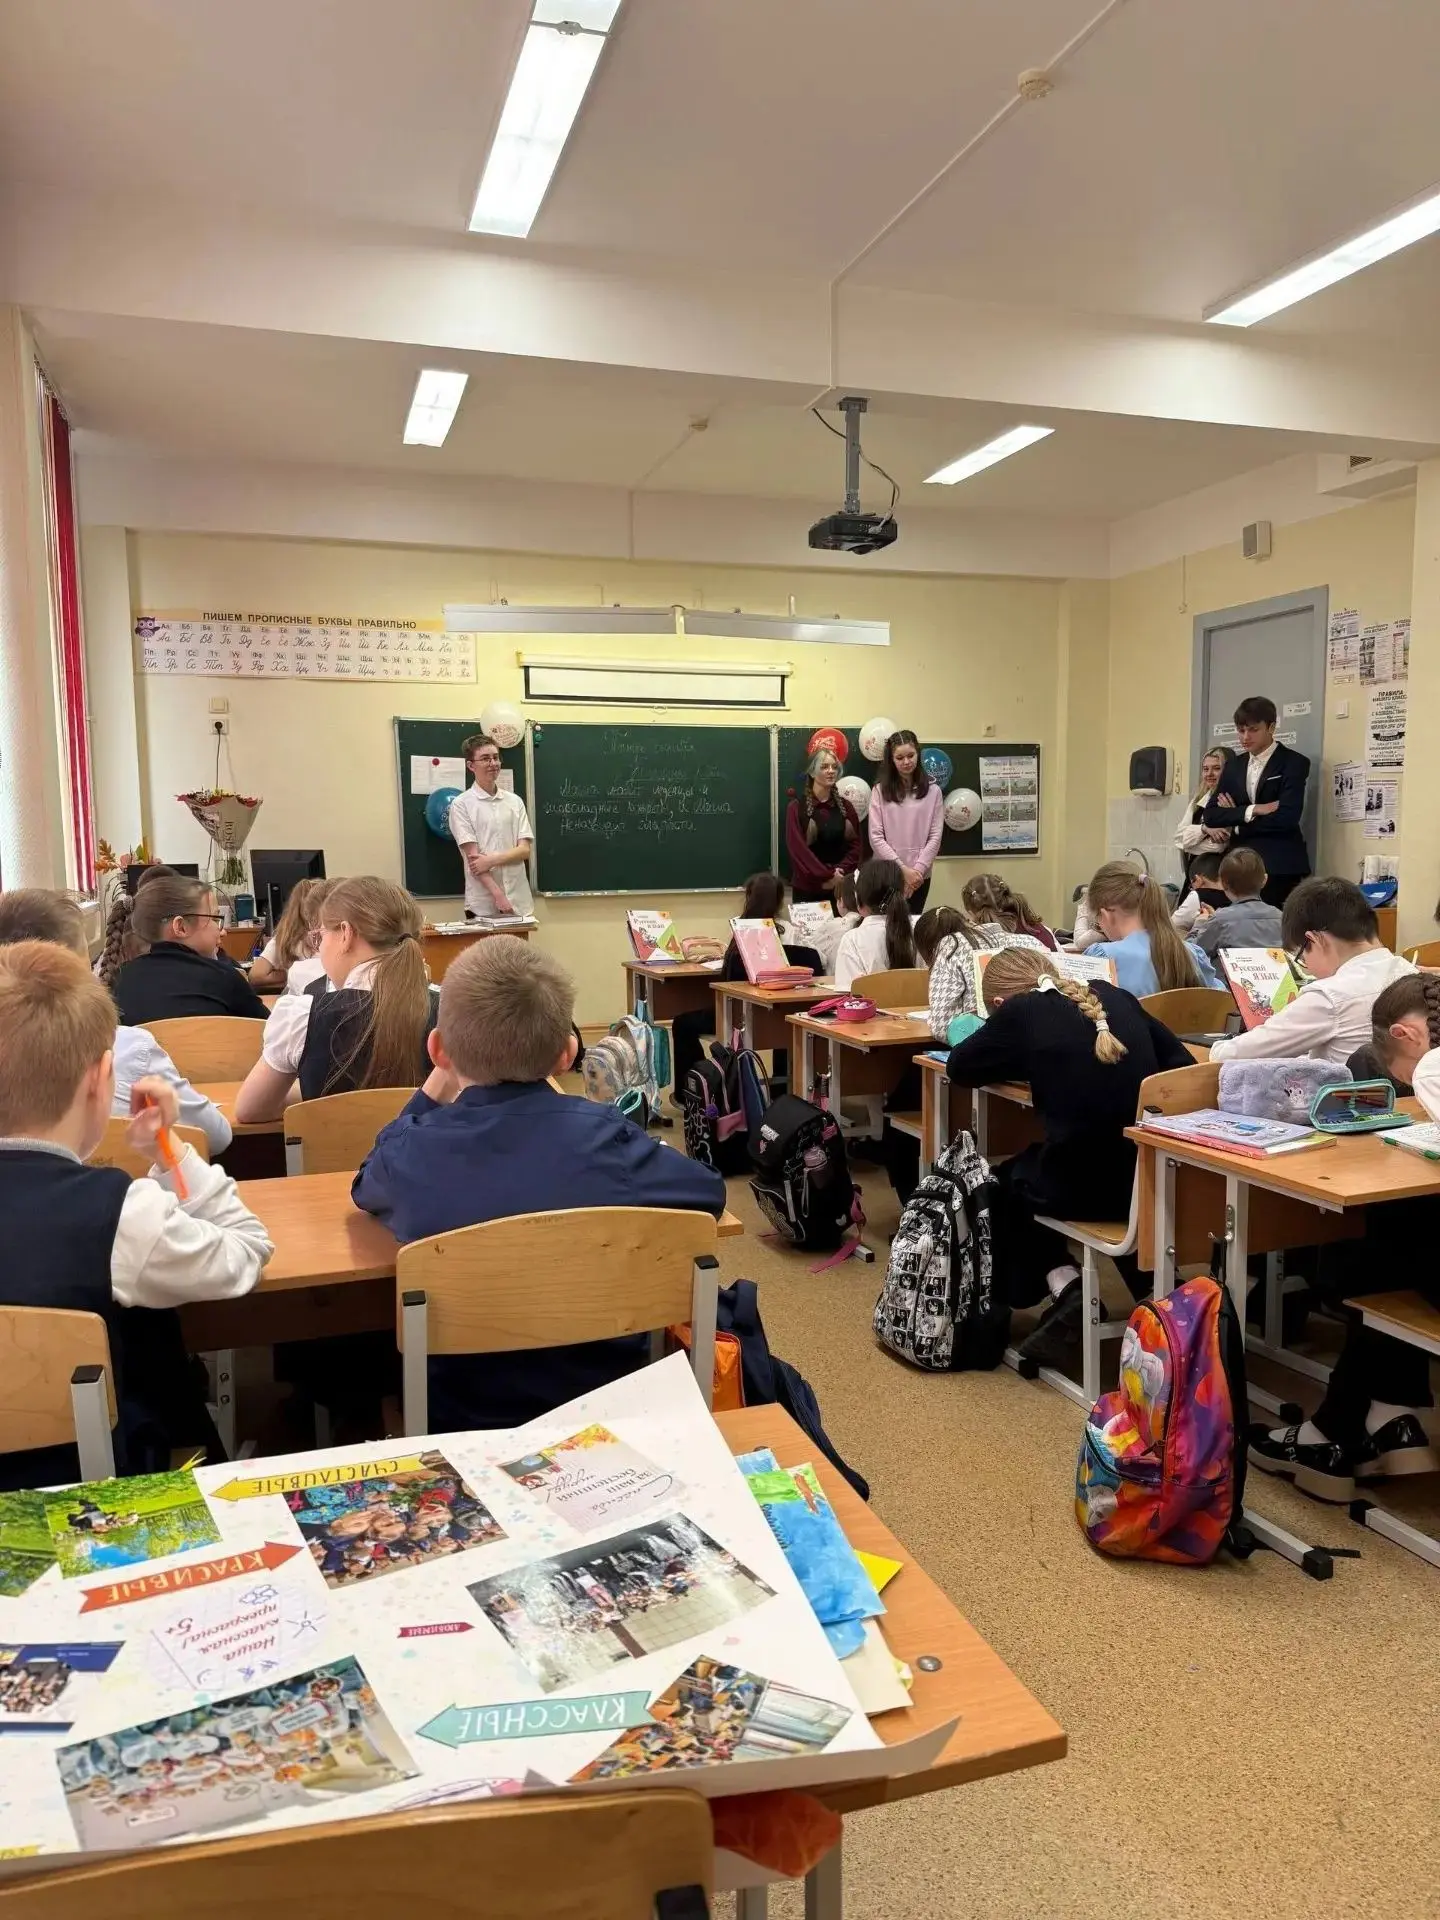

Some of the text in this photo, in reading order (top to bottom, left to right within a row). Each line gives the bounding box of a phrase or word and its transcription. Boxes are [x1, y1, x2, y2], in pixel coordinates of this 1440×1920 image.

[203, 612, 417, 629] ПИШЕМ ПРОПИСНЫЕ БУКВЫ ПРАВИЛЬНО
[666, 934, 681, 955] 4
[1230, 962, 1266, 973] Русский
[252, 1461, 399, 1493] СЧАСТЛИВЫЕ
[546, 1468, 597, 1504] труд!
[556, 1468, 637, 1502] бесценный
[606, 1470, 653, 1494] за ваш
[592, 1474, 673, 1516] Спасибо
[108, 1551, 265, 1602] КРАСИВЫЕ
[165, 1617, 194, 1636] 5+
[182, 1603, 277, 1650] прекрасна!
[199, 1618, 280, 1654] классная
[408, 1623, 461, 1637] ЛЮБИМЫЕ
[223, 1635, 276, 1661] Наша
[455, 1697, 626, 1740] КЛАССНЫЕ
